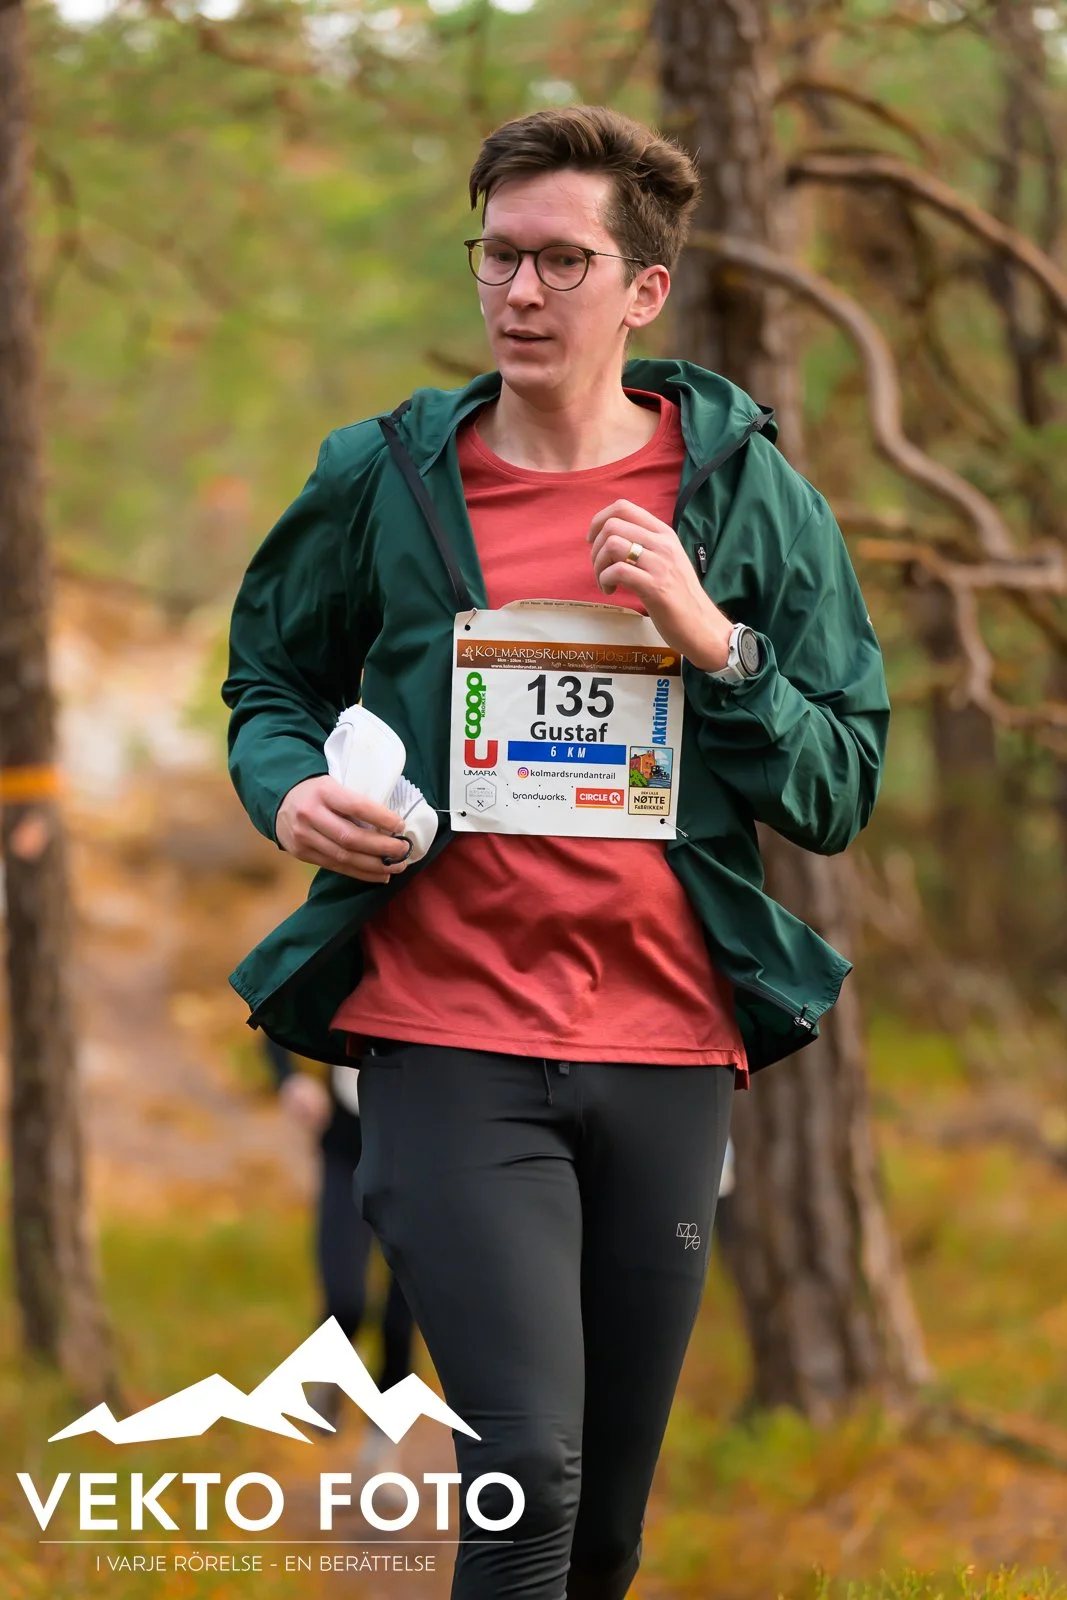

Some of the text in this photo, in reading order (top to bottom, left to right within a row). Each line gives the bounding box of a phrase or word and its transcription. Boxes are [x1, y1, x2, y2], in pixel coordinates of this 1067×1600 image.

[527, 674, 615, 718] 135
[465, 671, 487, 739] coop
[652, 678, 670, 745] Aktivitus
[530, 721, 609, 743] Gustaf
[550, 746, 557, 758] 6
[463, 769, 498, 777] UMARA
[530, 769, 616, 780] kolmardsrundantrail
[579, 793, 608, 802] CIRCLE
[633, 795, 666, 805] NØTTE
